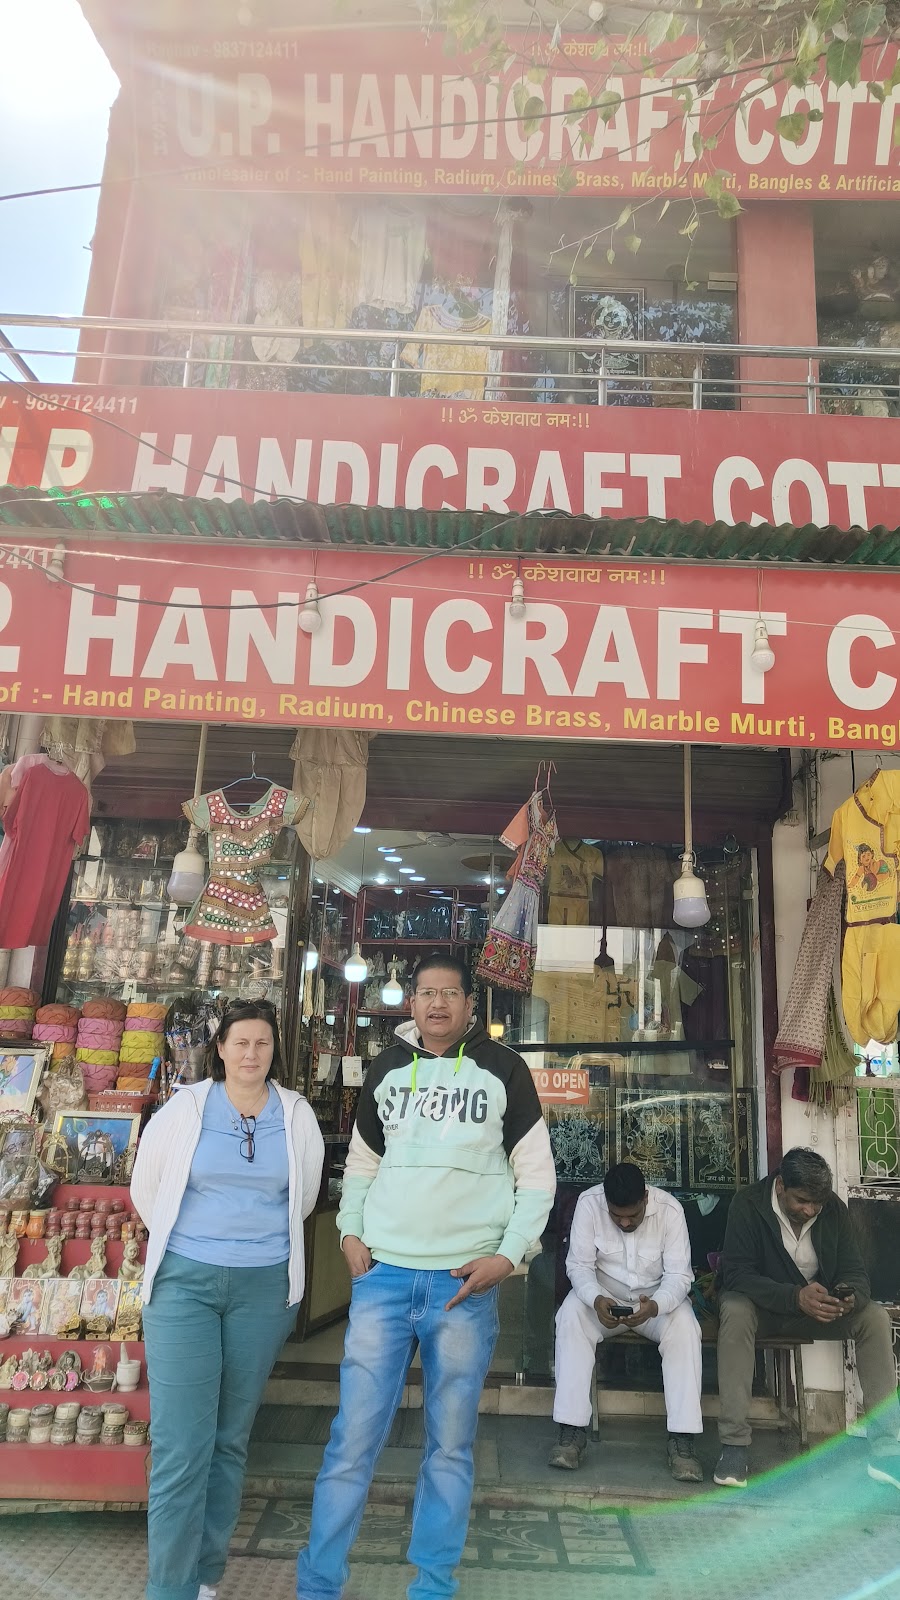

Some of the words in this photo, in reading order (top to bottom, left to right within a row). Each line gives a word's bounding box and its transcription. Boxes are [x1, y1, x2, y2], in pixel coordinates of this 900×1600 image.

[213, 41, 299, 59] 9837124411
[176, 72, 282, 157] U.P.
[304, 73, 716, 163] HANDICRAFT
[275, 166, 290, 183] of
[314, 168, 353, 184] Hand
[359, 168, 427, 188] Painting,
[434, 168, 501, 187] Radium,
[576, 172, 624, 190] Brass,
[631, 172, 688, 188] Marble
[748, 174, 813, 192] Bangles
[818, 175, 831, 190] &
[25, 394, 138, 414] 9837124411
[458, 408, 478, 424] ॐ
[482, 407, 543, 427] केशवाय
[131, 432, 682, 522] HANDICRAFT
[491, 563, 517, 580] ॐ
[522, 563, 603, 583] केशवाय
[63, 583, 788, 705] HANDICRAFT
[63, 684, 133, 708] Hand
[143, 687, 266, 719] Painting,
[279, 693, 394, 724] Radium,
[406, 699, 516, 726] Chinese
[526, 704, 611, 731] Brass,
[623, 707, 720, 734] Marble
[731, 712, 816, 742] Murti,
[553, 1072, 587, 1089] OPEN
